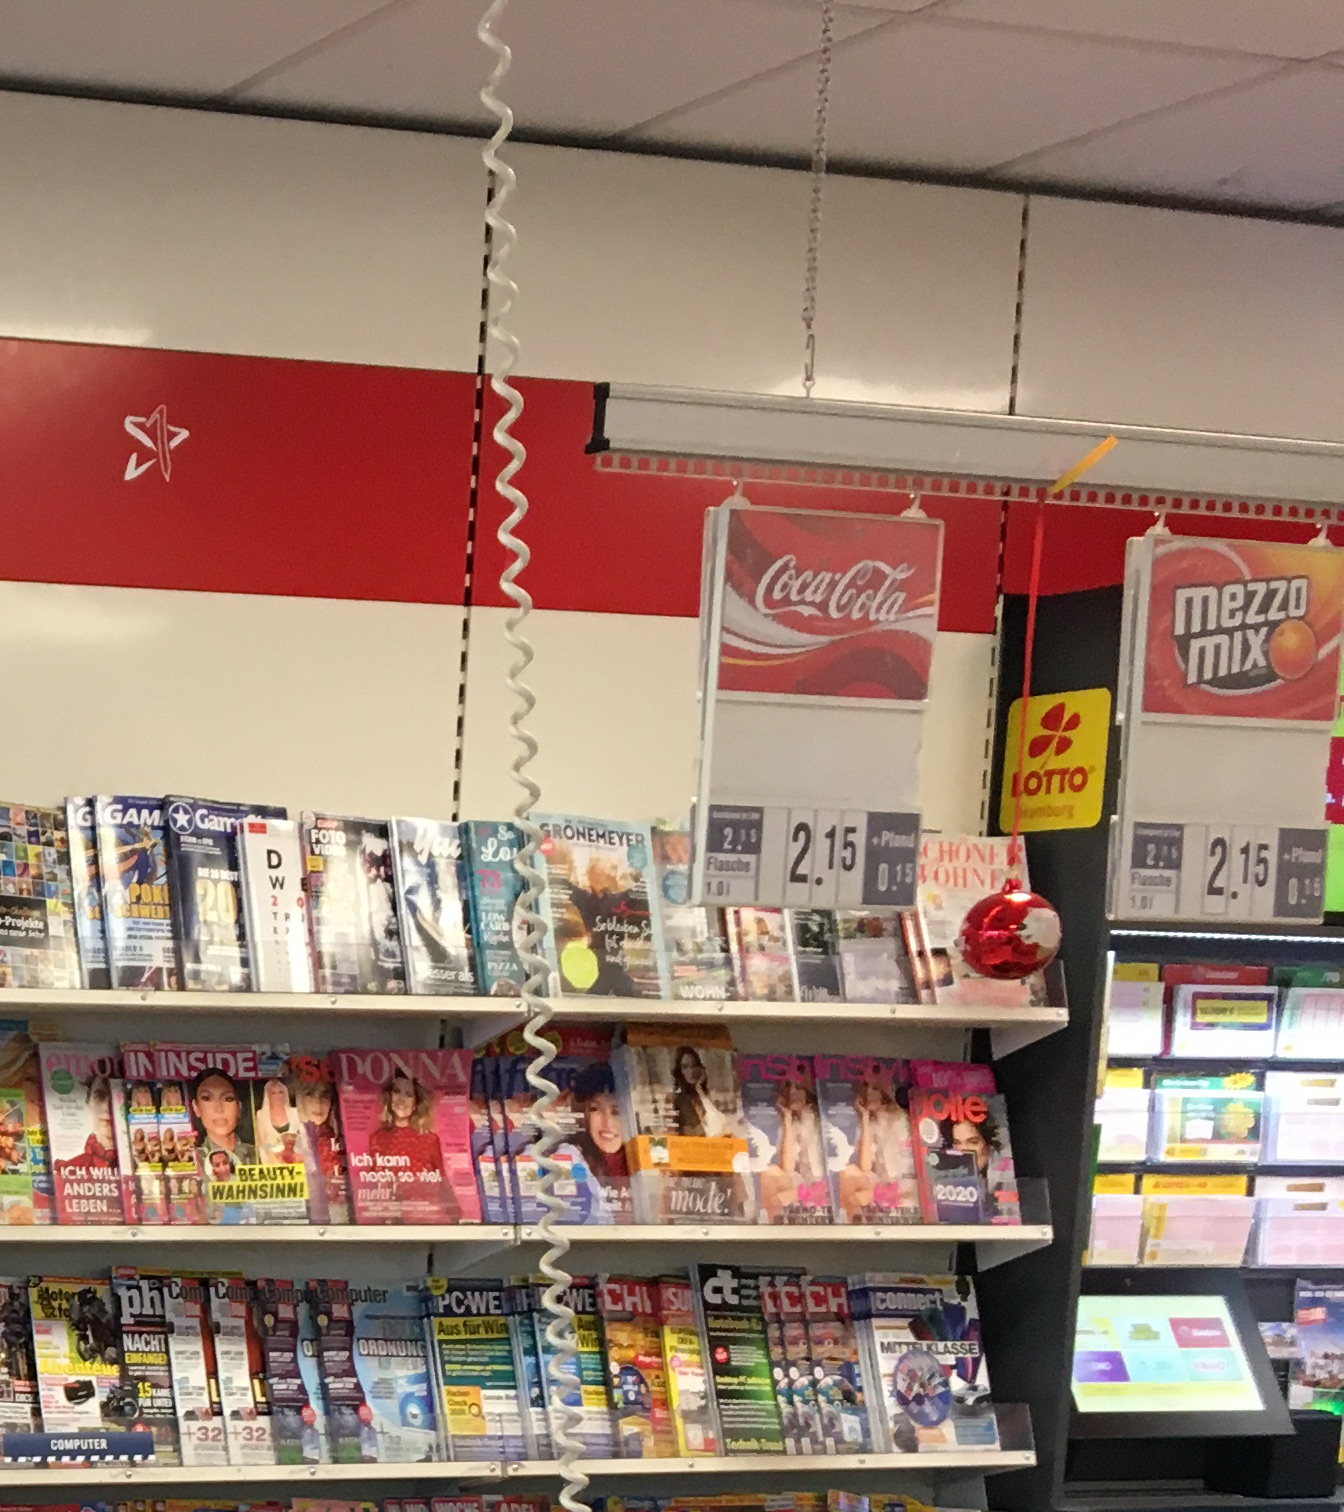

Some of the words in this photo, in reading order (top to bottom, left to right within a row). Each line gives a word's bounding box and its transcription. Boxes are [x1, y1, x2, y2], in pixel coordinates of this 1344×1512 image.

[1174, 576, 1308, 628] mezzo
[1185, 627, 1269, 685] mix
[539, 823, 646, 848] GRÖNEMEYER
[789, 821, 858, 886] 2.15
[1207, 837, 1270, 899] 2.15
[159, 1051, 256, 1080] INSIDE
[340, 1052, 470, 1085] DONNA
[350, 1152, 372, 1167] Ich
[374, 1153, 411, 1168] kann
[238, 1167, 302, 1183] BEAUTY-
[359, 1169, 390, 1183] noch
[63, 1181, 119, 1197] ANDERS
[211, 1182, 307, 1201] WAHNSINN!
[935, 1184, 978, 1202] 2020
[50, 1437, 107, 1452] COMPUTER
